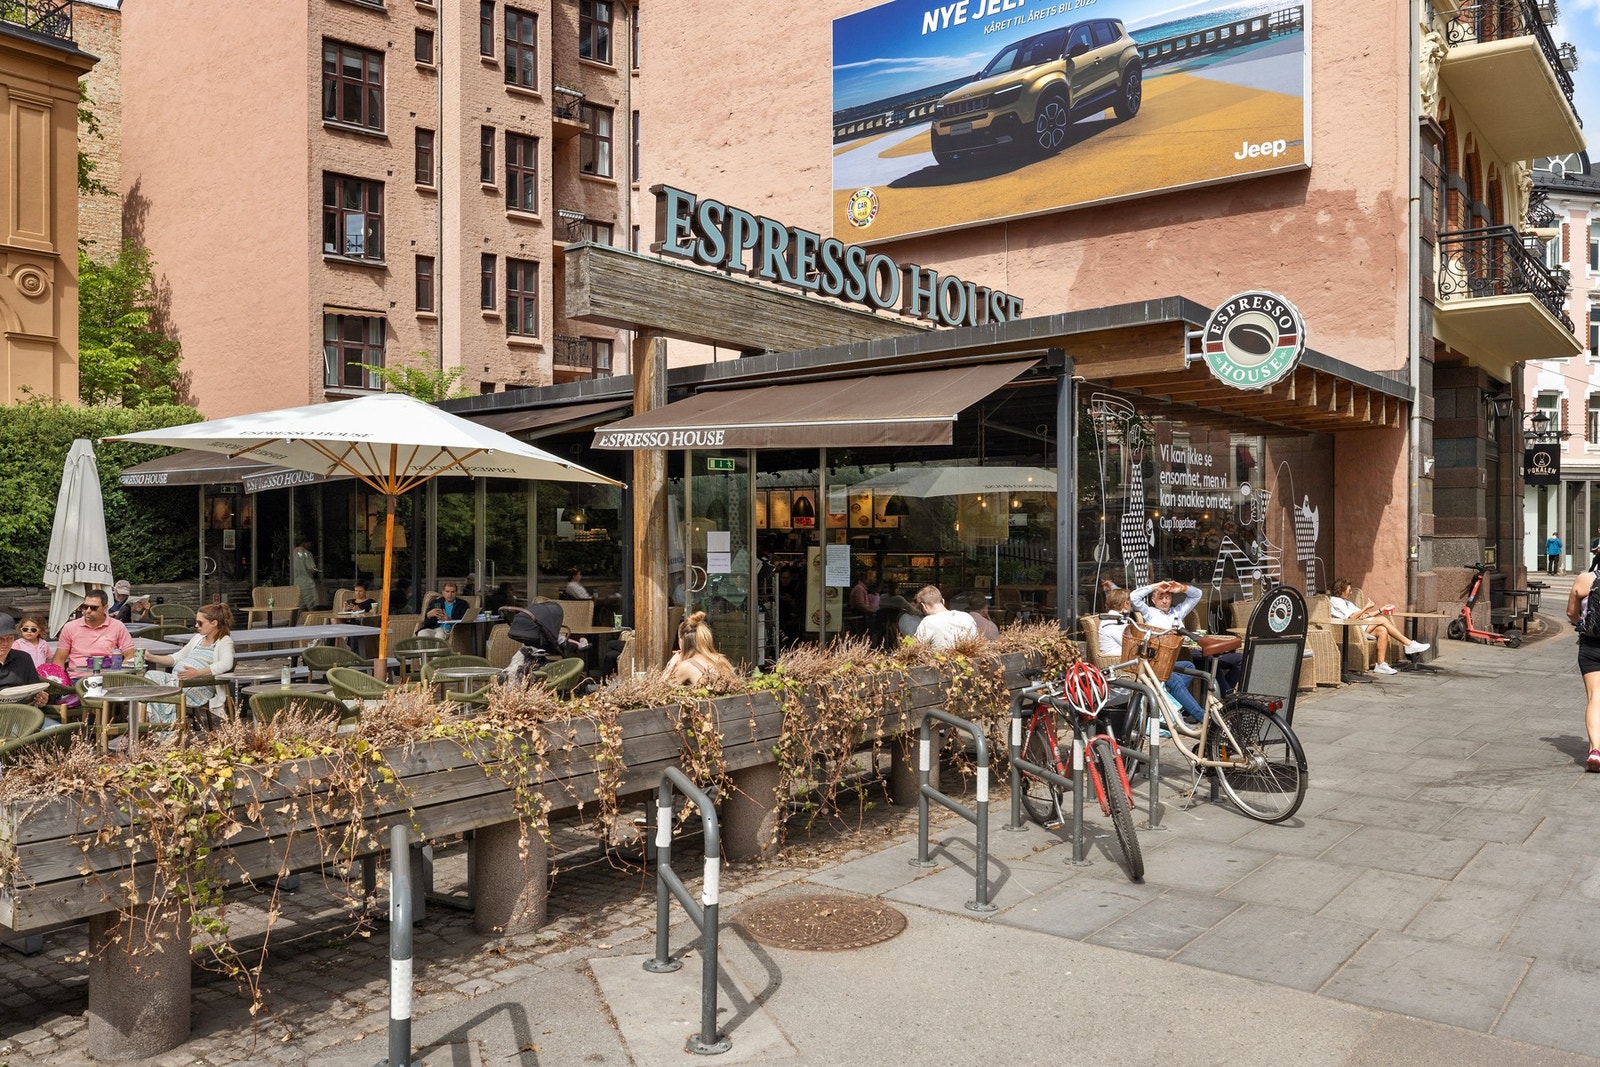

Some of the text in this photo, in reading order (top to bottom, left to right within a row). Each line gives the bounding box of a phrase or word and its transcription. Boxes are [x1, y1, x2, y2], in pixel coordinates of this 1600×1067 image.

[921, 0, 970, 35] NYE
[983, 18, 1012, 35] KÅRET
[1014, 15, 1027, 26] TIL
[1027, 5, 1057, 22] ÅRETS
[1059, 2, 1073, 14] BIL
[1234, 139, 1287, 160] Jeep
[652, 184, 901, 309] ESPRESSO
[1210, 296, 1293, 335] ESPRESSO
[1219, 357, 1284, 382] HOUSE
[598, 430, 725, 447] ESPRESSO HOUSE
[1160, 444, 1213, 467] Vi kan ikke se
[144, 473, 168, 484] HOUSE
[284, 471, 315, 485] HOUSE
[1160, 469, 1227, 488] ensomhet, men vi
[1526, 467, 1557, 475] POKALEN
[1160, 489, 1233, 509] kan snakke om det.
